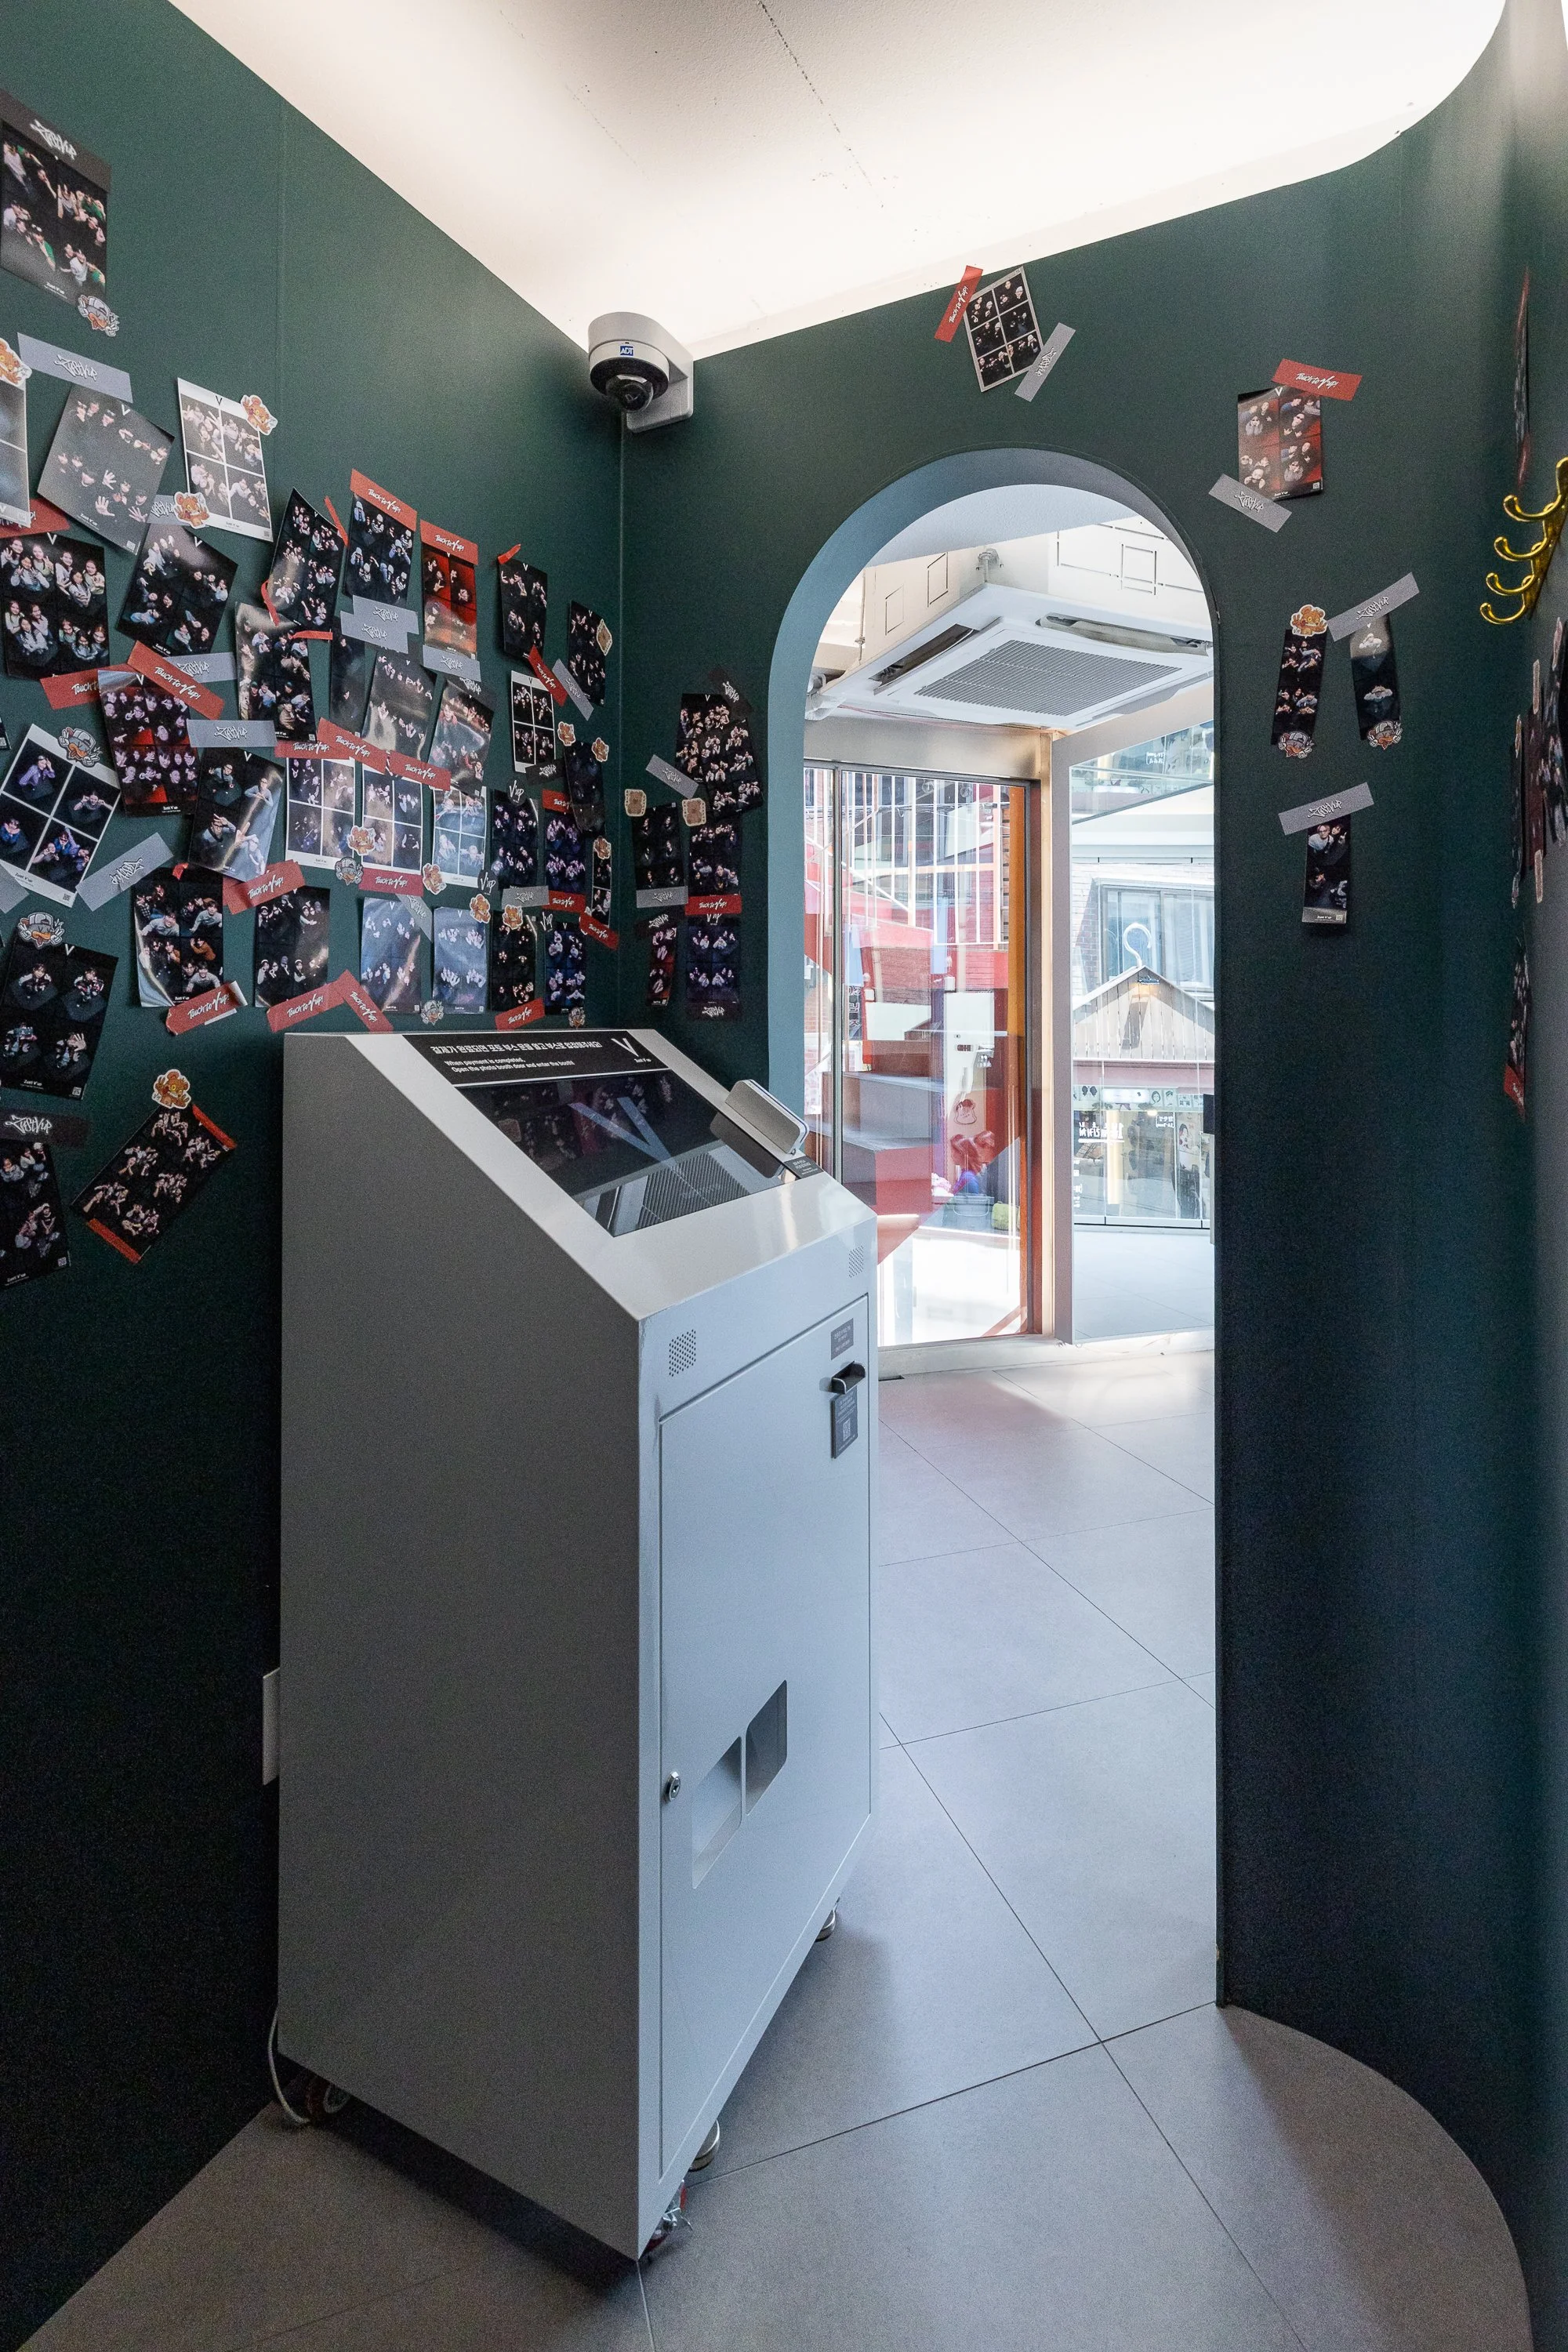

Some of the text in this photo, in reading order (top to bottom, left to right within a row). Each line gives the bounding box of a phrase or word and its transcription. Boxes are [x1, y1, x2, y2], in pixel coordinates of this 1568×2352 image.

[620, 346, 634, 356] ADT
[155, 666, 175, 684] Touch
[71, 682, 92, 695] Touch
[430, 1046, 459, 1054] 결제가
[456, 1044, 490, 1053] 완료되면
